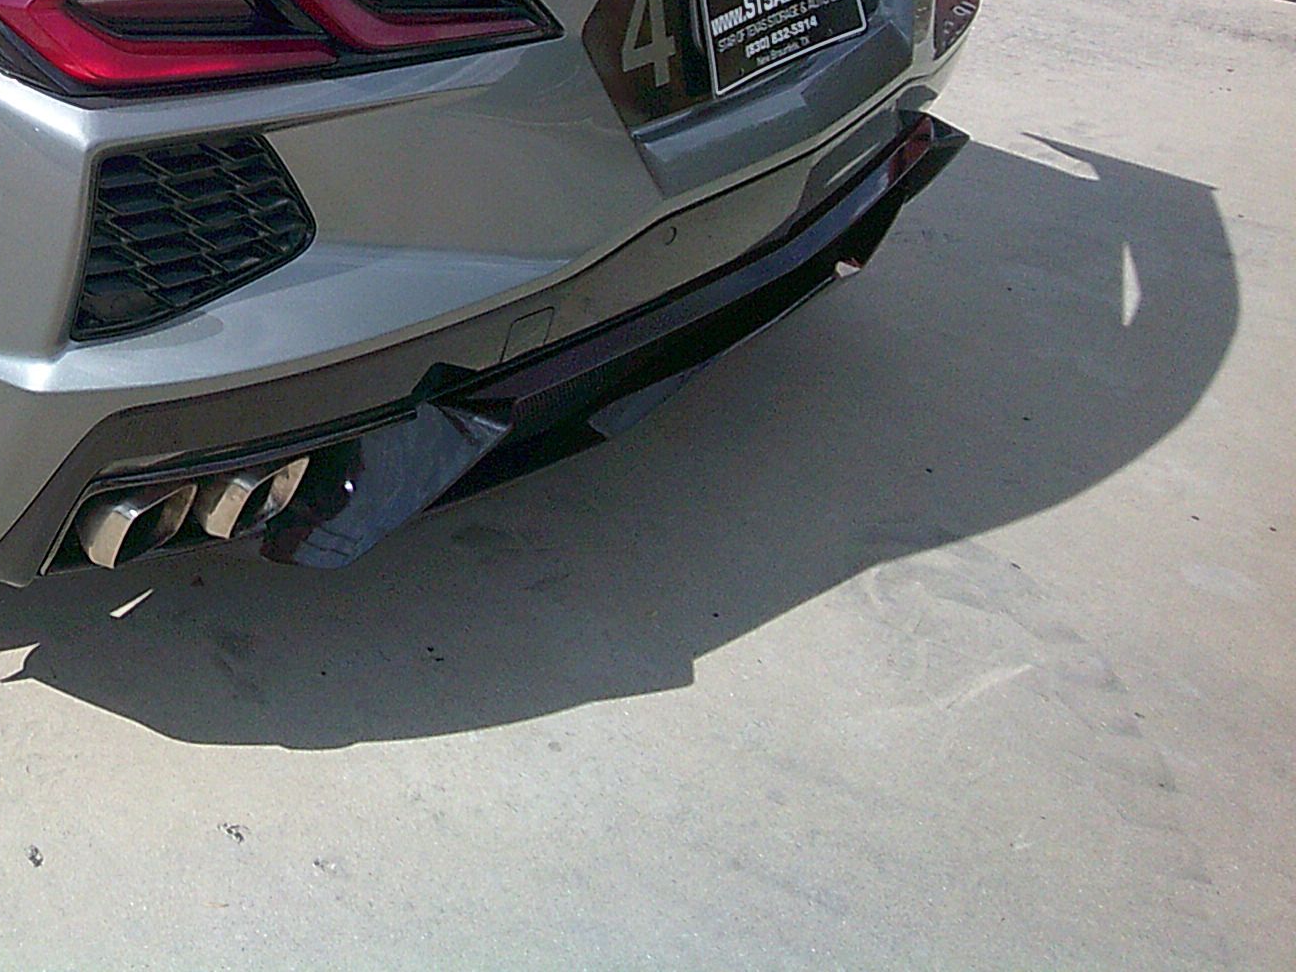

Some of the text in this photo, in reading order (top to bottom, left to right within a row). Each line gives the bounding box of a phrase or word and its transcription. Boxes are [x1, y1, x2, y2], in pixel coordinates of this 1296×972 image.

[718, 34, 737, 52] STAR
[736, 28, 745, 43] OF
[745, 18, 768, 37] TEXAS
[768, 4, 802, 26] STORAGE
